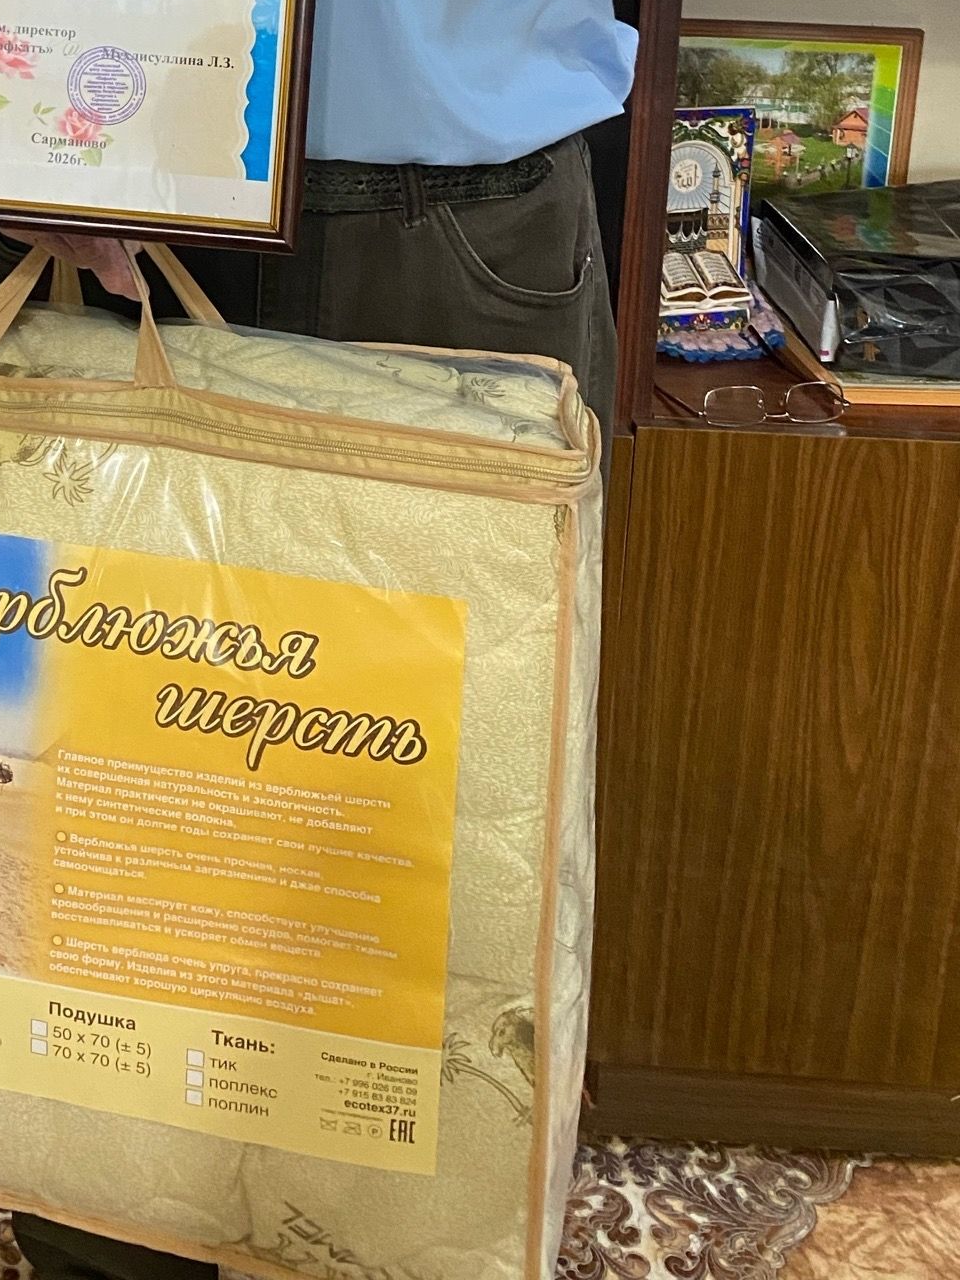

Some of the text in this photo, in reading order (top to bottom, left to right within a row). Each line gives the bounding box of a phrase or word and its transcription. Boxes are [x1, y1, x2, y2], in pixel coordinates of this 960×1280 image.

[13, 24, 76, 40] директор
[207, 55, 235, 69] Л.З.
[31, 132, 107, 150] Сарманово
[47, 151, 87, 166] 2026г.
[154, 678, 429, 770] шерсть
[57, 765, 346, 816] их совершенная натуральность экологичность.
[58, 749, 390, 808] Главное преимущество изделий из верблюжьей шерсти
[56, 777, 112, 794] Материал
[114, 787, 188, 806] практически
[191, 799, 206, 809] не
[288, 814, 303, 823] не
[306, 817, 373, 834] добавляют
[65, 793, 94, 807] нему
[96, 798, 182, 819] синтетические
[64, 807, 416, 868] при этом он долгие годы сохраняет свои лучшие качества.
[69, 833, 138, 852] Верблюжья
[140, 845, 183, 858] шерсть
[186, 852, 221, 864] очень
[52, 858, 148, 879] самоочищаться.
[54, 845, 112, 861] устойчива
[124, 856, 192, 873] различным
[194, 866, 276, 886] загрязнениям
[324, 886, 381, 902] способна
[67, 886, 124, 903] Материал
[126, 897, 188, 914] массирует
[226, 912, 307, 932] способствует
[310, 925, 380, 943] улучшению
[50, 911, 161, 934] восстанавливаться
[174, 929, 227, 944] ускоряет
[230, 936, 268, 950] обмен
[51, 898, 150, 920] кровообращения
[163, 915, 238, 934] расширению
[296, 936, 352, 951] помогает
[354, 945, 398, 959] тканям
[49, 951, 294, 997] свою форму. Изделия из этого материала
[65, 937, 108, 953] Шерсть
[112, 947, 169, 963] верблюда
[171, 956, 206, 969] очень
[254, 969, 318, 987] прекрасно
[320, 980, 384, 997] сохраняет
[49, 963, 130, 984] обеспечивают
[133, 977, 188, 994] хорошую
[190, 986, 262, 1005] циркуляцию
[48, 1001, 137, 1032] Подушка
[52, 1025, 73, 1041] 50
[90, 1033, 111, 1049] 70
[211, 1028, 276, 1055] Ткань:
[52, 1044, 73, 1060] 70
[90, 1052, 111, 1068] 70
[210, 1057, 238, 1072] тик
[321, 1051, 367, 1068] Сделано
[379, 1061, 419, 1076] России
[209, 1077, 278, 1100] поплекс
[339, 1077, 350, 1086] +7
[377, 1072, 418, 1086] Иваново
[338, 1088, 350, 1096] +7
[352, 1089, 369, 1099] 915
[208, 1097, 270, 1117] поплин
[344, 1099, 417, 1118] ecotex37.ru
[389, 1118, 416, 1144] EAC
